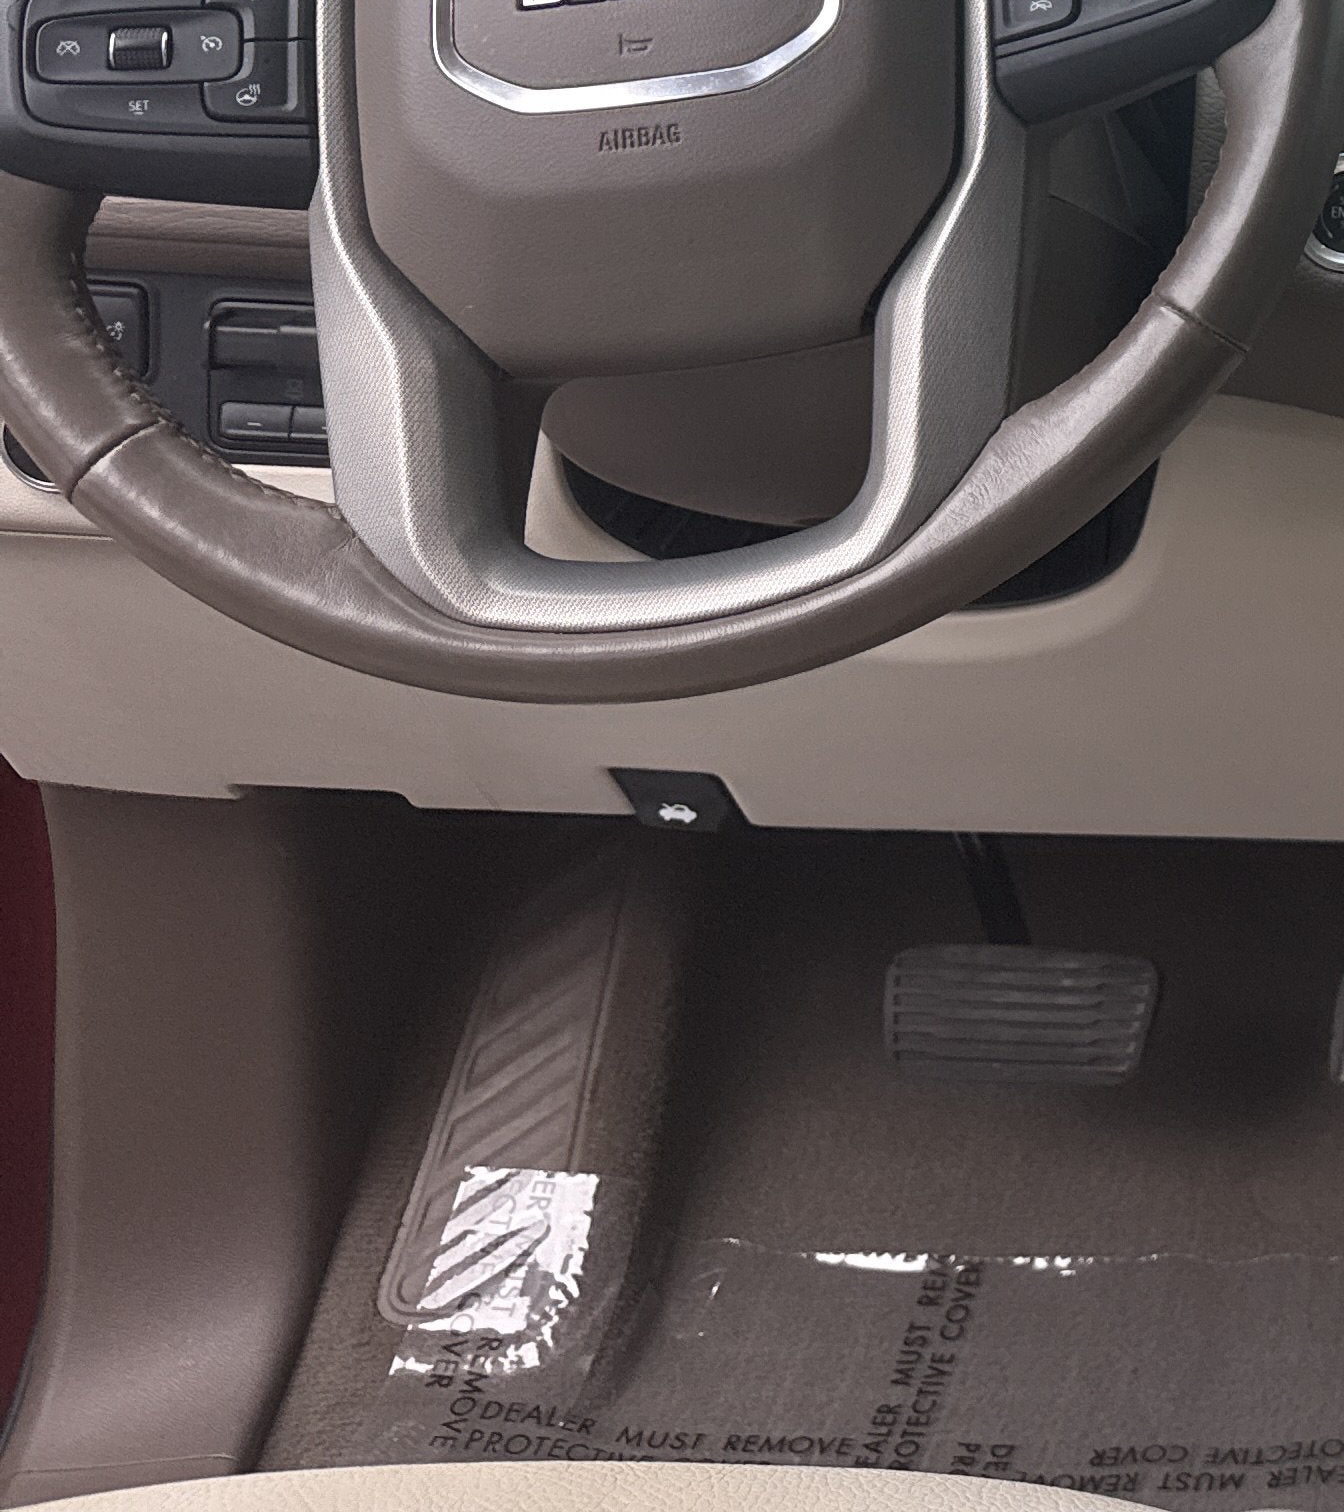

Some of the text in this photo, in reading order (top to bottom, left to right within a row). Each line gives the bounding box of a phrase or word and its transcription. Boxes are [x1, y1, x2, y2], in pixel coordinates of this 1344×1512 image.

[128, 99, 150, 112] SET
[599, 123, 681, 152] AIRBAG
[855, 1402, 902, 1469] EALER
[890, 1322, 931, 1387] MUST
[888, 1351, 956, 1472] ROTECTIVE
[480, 1399, 856, 1457] DEALER MUST REMOVE
[1088, 1443, 1189, 1468] COVER
[1158, 1472, 1247, 1491] MUST
